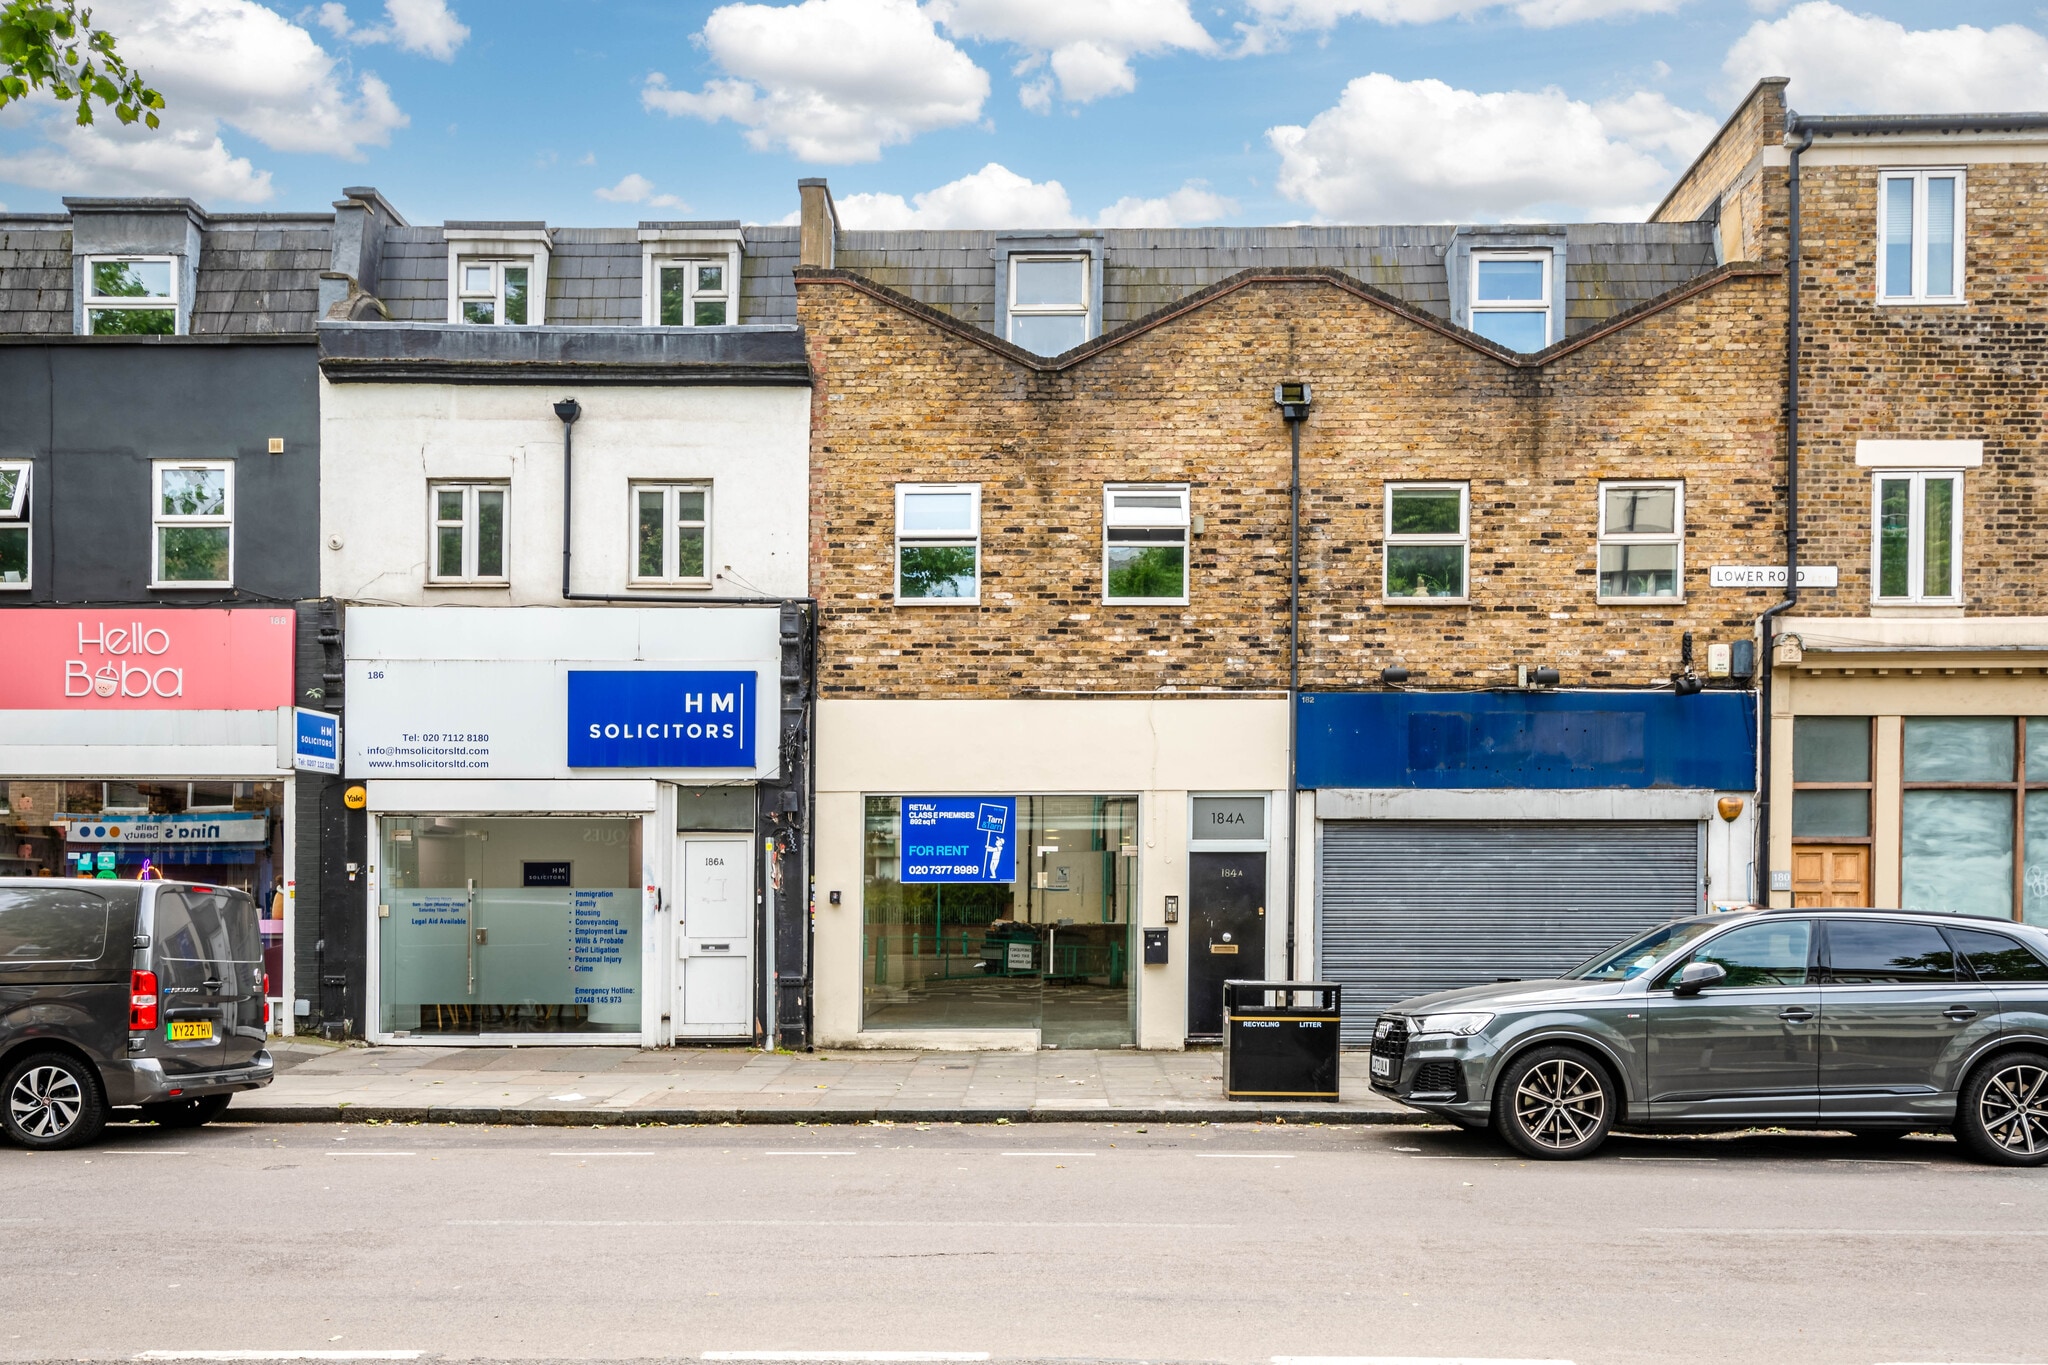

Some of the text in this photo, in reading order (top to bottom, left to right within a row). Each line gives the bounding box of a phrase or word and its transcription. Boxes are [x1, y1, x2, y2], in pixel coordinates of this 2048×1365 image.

[1717, 571, 1764, 582] LOWER
[1769, 571, 1806, 582] ROD
[269, 615, 287, 625] 188
[77, 621, 170, 655] Hello
[367, 671, 384, 679] 186
[685, 692, 735, 713] HM
[1302, 696, 1315, 704] 182
[320, 726, 332, 737] HM
[589, 723, 735, 739] SOLICITORS
[301, 735, 332, 748] SOLICITORS
[402, 733, 489, 742] Tel: 020 7112 8180
[367, 745, 489, 757] info@hmsolicitorsltd.com
[368, 759, 489, 769] www.hmsolicitorsltd.com
[346, 794, 363, 803] Yale
[1211, 812, 1245, 825] 184A
[909, 846, 969, 856] FOR RENT
[705, 857, 725, 866] 186A
[908, 866, 979, 875] 020 7377 8989
[1774, 872, 1790, 882] 180
[575, 900, 597, 908] Family
[575, 909, 601, 917] Housing
[411, 918, 427, 926] Legal
[575, 918, 619, 927] Conveyancing
[575, 928, 614, 936] Employment
[590, 947, 619, 955] Litigation
[603, 956, 622, 964] Injury
[575, 987, 609, 995] Emergency
[575, 996, 622, 1004] 07448 145 973
[1243, 1021, 1322, 1029] RECYCLING LITTER
[173, 1023, 211, 1037] YY22 THV
